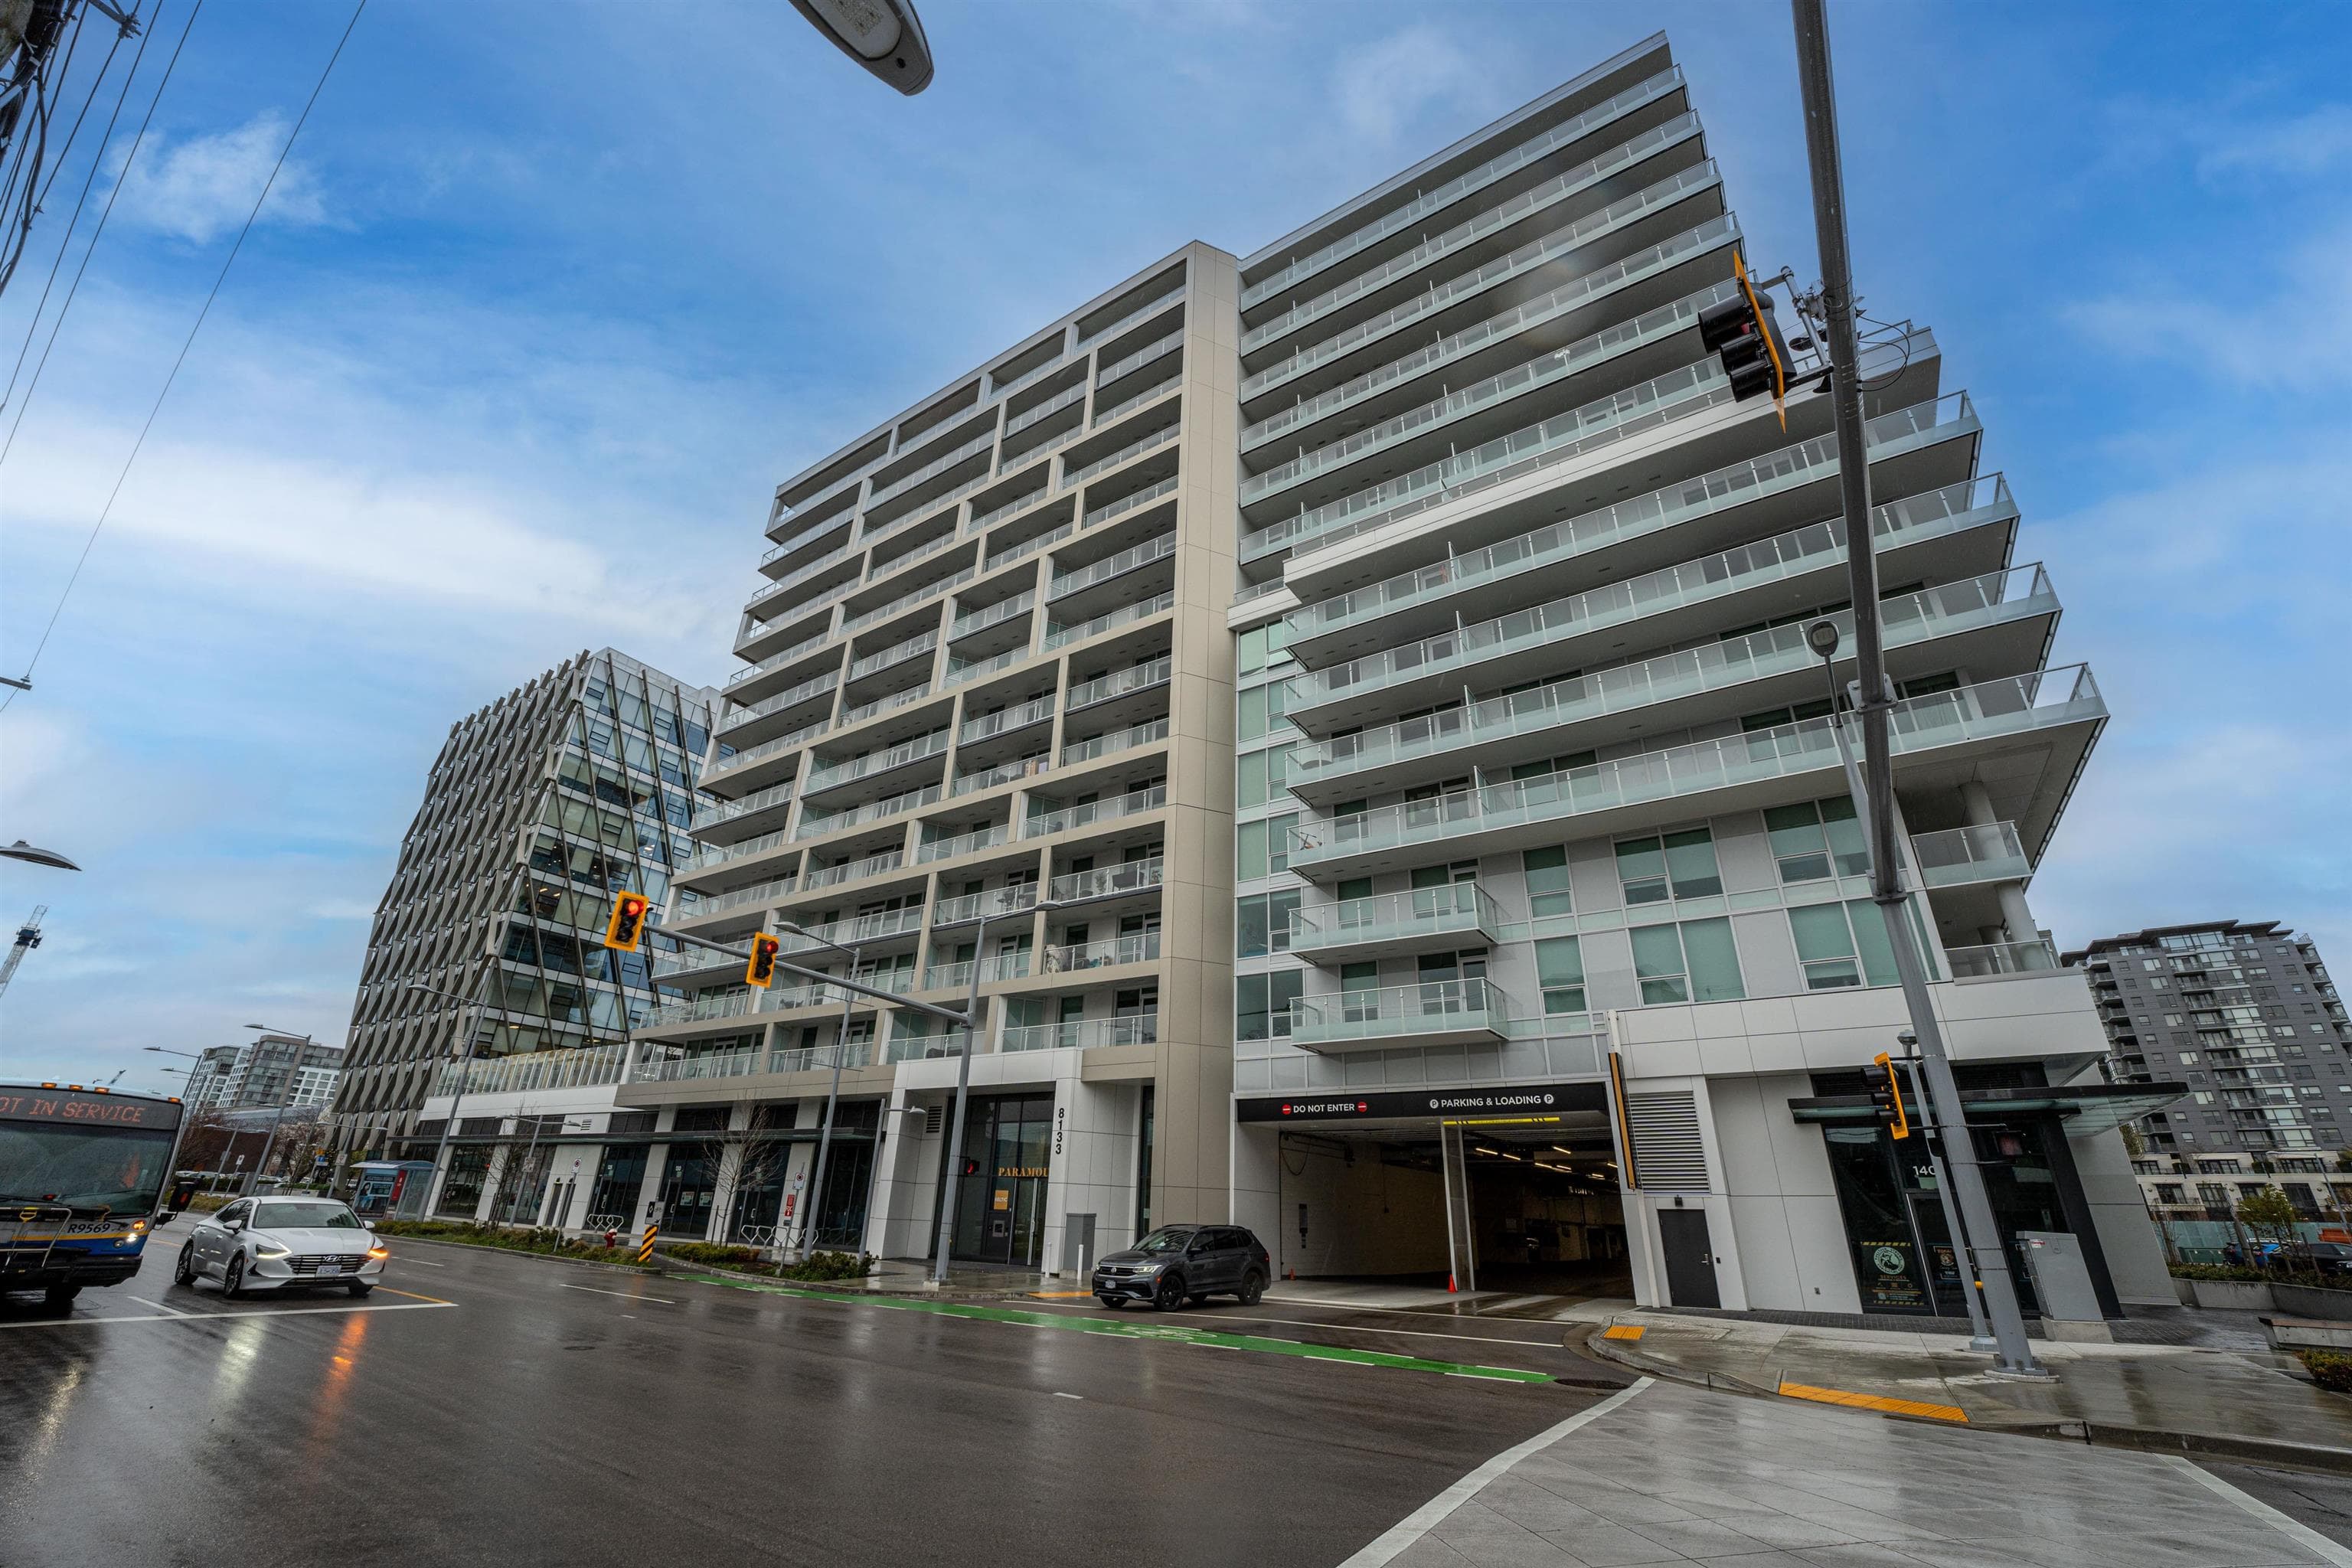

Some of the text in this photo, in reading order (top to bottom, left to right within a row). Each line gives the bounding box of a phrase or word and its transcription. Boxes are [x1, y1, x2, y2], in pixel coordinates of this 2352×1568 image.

[1293, 1103, 1354, 1113] DO NOT ENTER
[1441, 1098, 1484, 1108] PARKING
[1485, 1097, 1493, 1106] &
[1495, 1095, 1541, 1106] LOADING
[29, 1099, 58, 1116] IN
[63, 1102, 146, 1122] SERVICE
[1055, 1107, 1065, 1155] 8133
[67, 1223, 111, 1233] R9569
